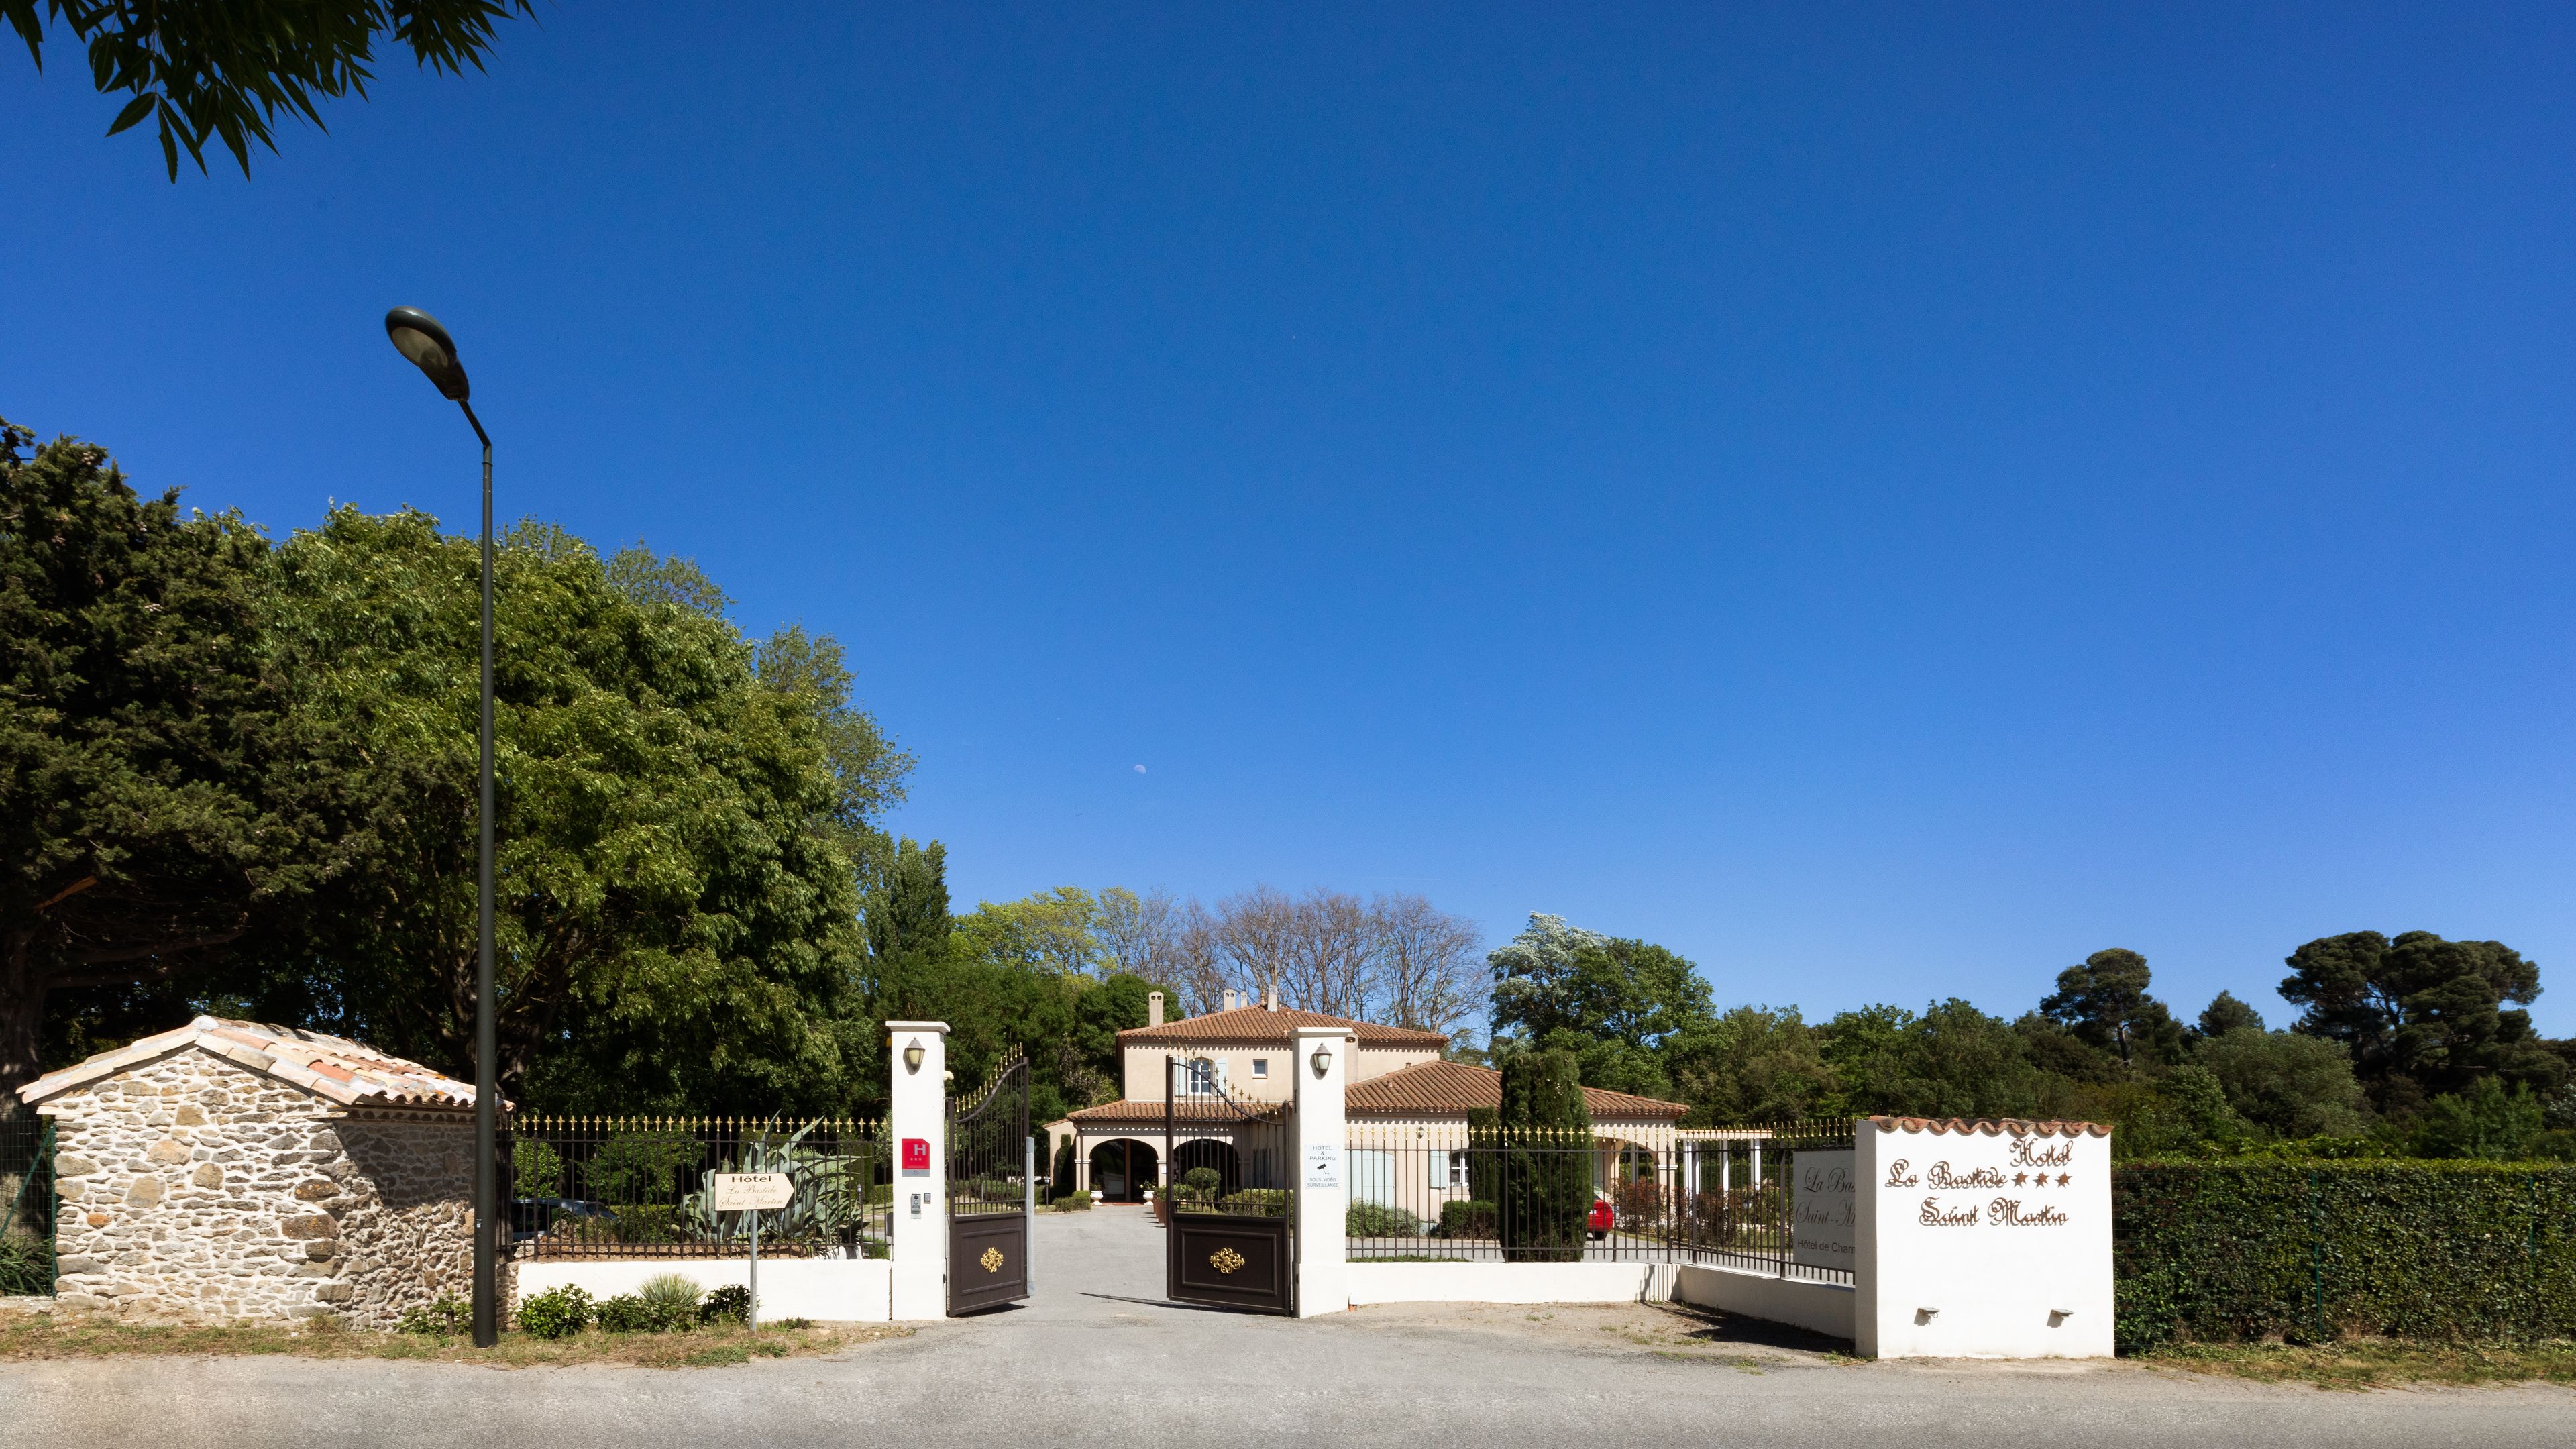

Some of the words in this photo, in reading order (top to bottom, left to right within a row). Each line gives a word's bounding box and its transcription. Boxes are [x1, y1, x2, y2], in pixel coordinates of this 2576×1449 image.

[914, 1144, 926, 1155] H
[2010, 1138, 2074, 1166] Hotel
[1803, 1167, 1823, 1193] La
[1885, 1159, 1920, 1187] La
[1928, 1161, 2008, 1189] Bastide
[726, 1185, 740, 1194] La
[743, 1185, 777, 1194] Bastide
[719, 1195, 746, 1208] Saint
[749, 1195, 782, 1205] Martin
[1919, 1197, 1980, 1226] Saint
[1988, 1197, 2069, 1226] Martin
[1798, 1239, 1817, 1250] Hôtel
[1819, 1242, 1829, 1252] de
